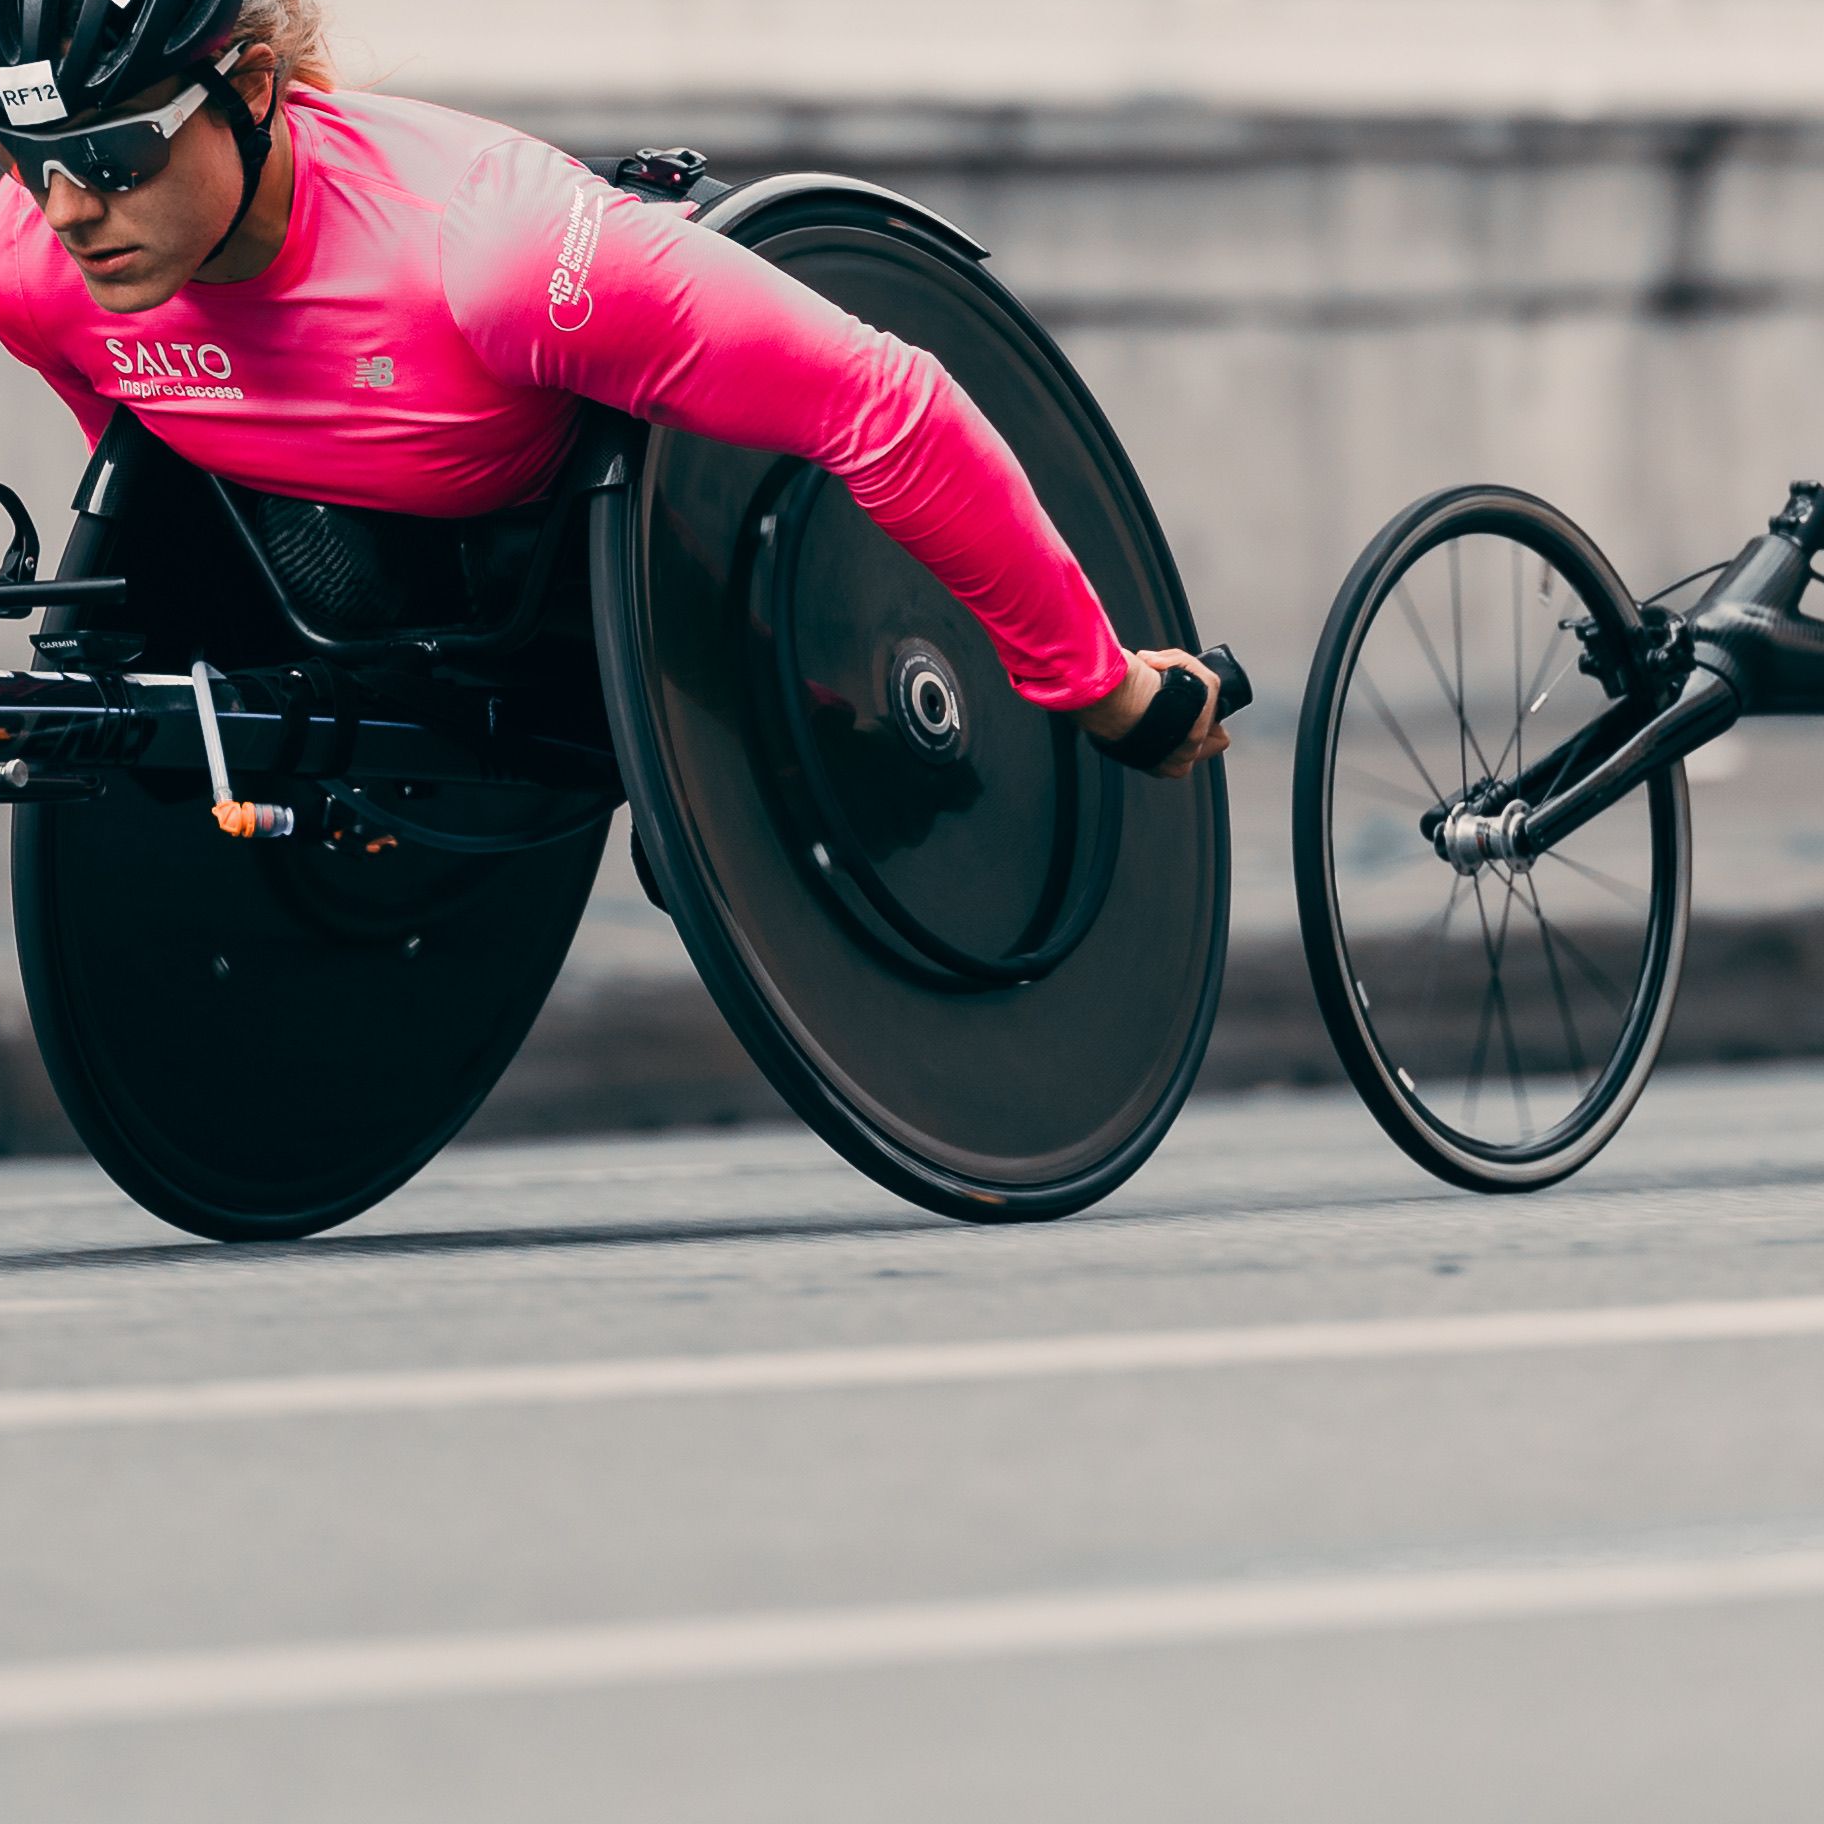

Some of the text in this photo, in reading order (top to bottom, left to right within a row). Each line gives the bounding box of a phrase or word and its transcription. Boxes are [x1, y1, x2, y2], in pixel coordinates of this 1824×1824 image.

[2, 84, 58, 106] RF12
[106, 338, 232, 380] SALTO
[39, 639, 78, 649] GARMIN
